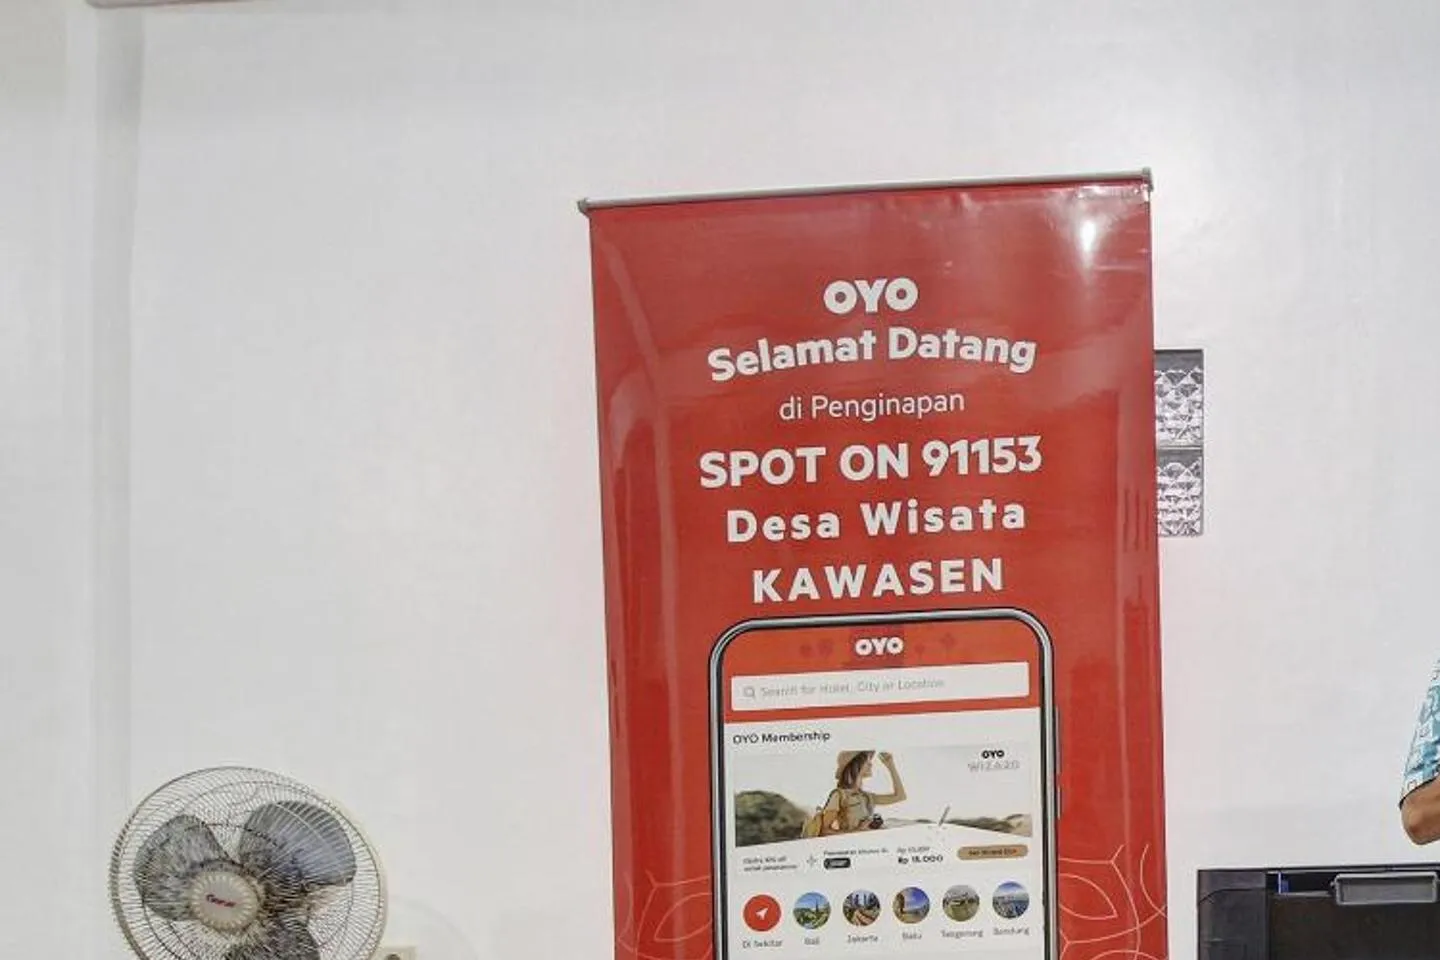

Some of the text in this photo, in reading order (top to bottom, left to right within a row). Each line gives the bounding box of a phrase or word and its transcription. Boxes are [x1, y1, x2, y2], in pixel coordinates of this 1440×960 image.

[823, 276, 919, 315] OYO
[707, 326, 1037, 381] Selamat Datang
[779, 392, 965, 422] di Penginapan
[699, 435, 1042, 489] SPOT ON 91153
[727, 498, 1025, 543] Desa Wisata
[752, 557, 1003, 603] KAWASEN
[855, 636, 904, 656] OYO
[733, 731, 831, 745] OYO Membership
[981, 749, 1005, 759] OYO
